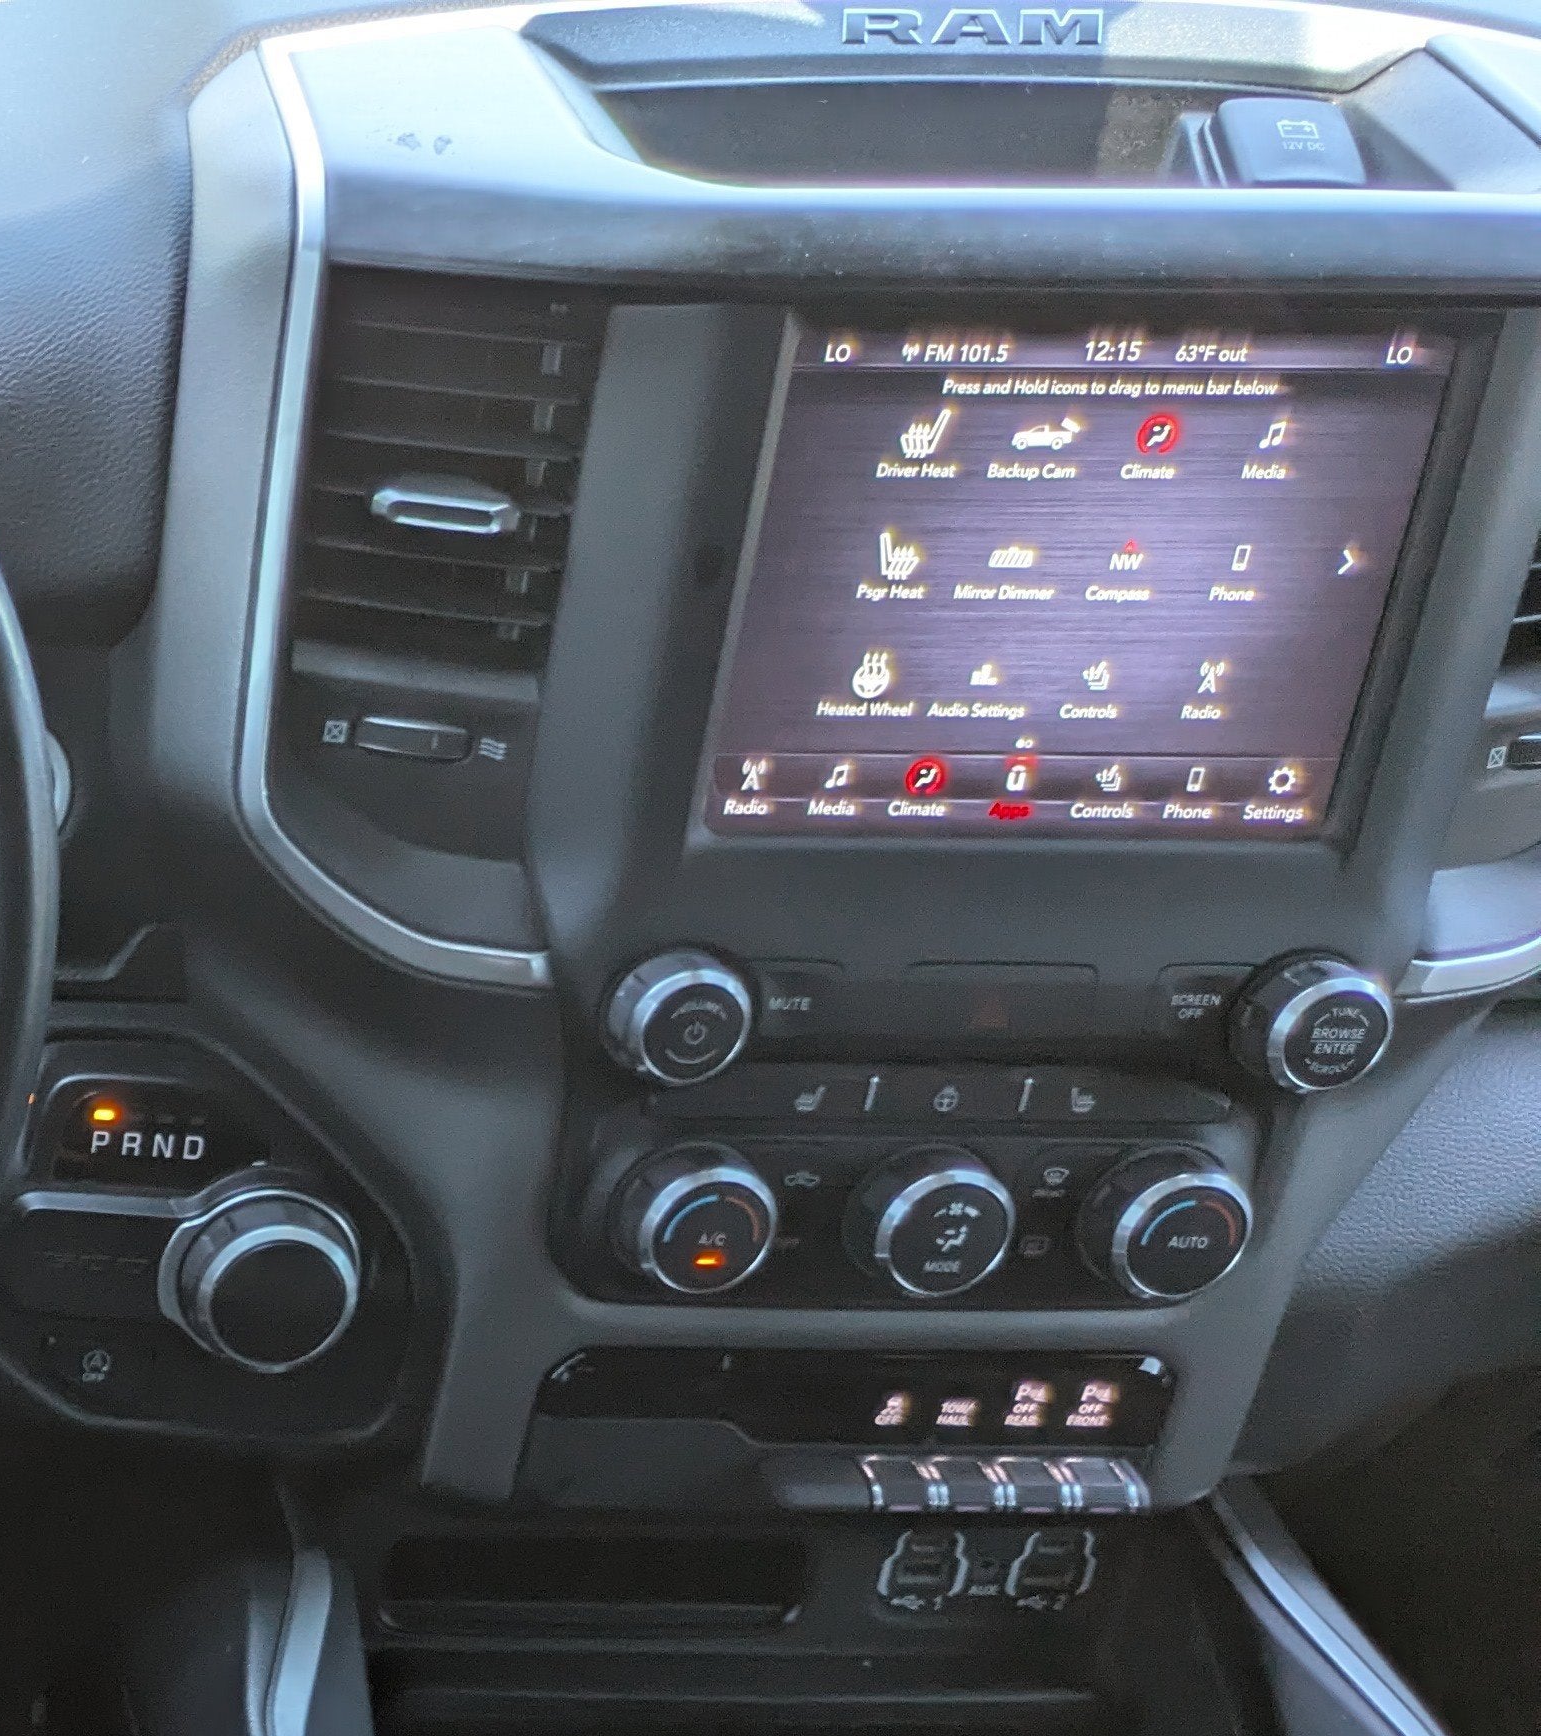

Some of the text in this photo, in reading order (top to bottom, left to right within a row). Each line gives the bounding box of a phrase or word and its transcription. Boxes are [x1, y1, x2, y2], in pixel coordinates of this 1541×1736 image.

[841, 7, 1104, 46] RAM
[1282, 141, 1304, 151] 12V
[824, 343, 851, 363] LO
[924, 344, 1009, 363] FM 101.5
[1084, 340, 1143, 363] 12:15
[1175, 344, 1248, 363] 63°F out
[1385, 345, 1413, 365] LO
[942, 378, 1278, 398] Press and Hold icons to drag to menu bar below
[876, 462, 957, 479] Driver Heat
[987, 462, 1077, 481] Backup Cam
[1120, 463, 1175, 480] Climate
[1241, 463, 1287, 480] Media
[1109, 554, 1144, 571] NW
[856, 584, 924, 601] Psgr Heat
[953, 584, 1055, 600] Mirror Dimmer
[1085, 585, 1150, 603] Compass
[1209, 585, 1255, 602] Phone
[816, 701, 914, 717] Heated Wheel
[927, 702, 1025, 720] Audio Settings
[1059, 704, 1118, 719] Controls
[1180, 704, 1221, 720] Radio
[723, 799, 768, 816] Radio
[807, 800, 855, 817] Media
[887, 800, 946, 818] Climate
[988, 801, 1030, 819] Apps
[1070, 803, 1134, 820] Controls
[1162, 804, 1214, 820] Phone
[1243, 804, 1304, 823] Settings
[768, 996, 811, 1011] MUTE
[1171, 994, 1221, 1007] SCREEN
[1178, 1007, 1205, 1019] OFF
[1312, 1027, 1365, 1040] BROWSE
[1313, 1041, 1357, 1055] ENTER
[90, 1131, 206, 1160] P R N D
[1167, 1235, 1209, 1249] AUTO
[923, 1260, 961, 1273] MODE
